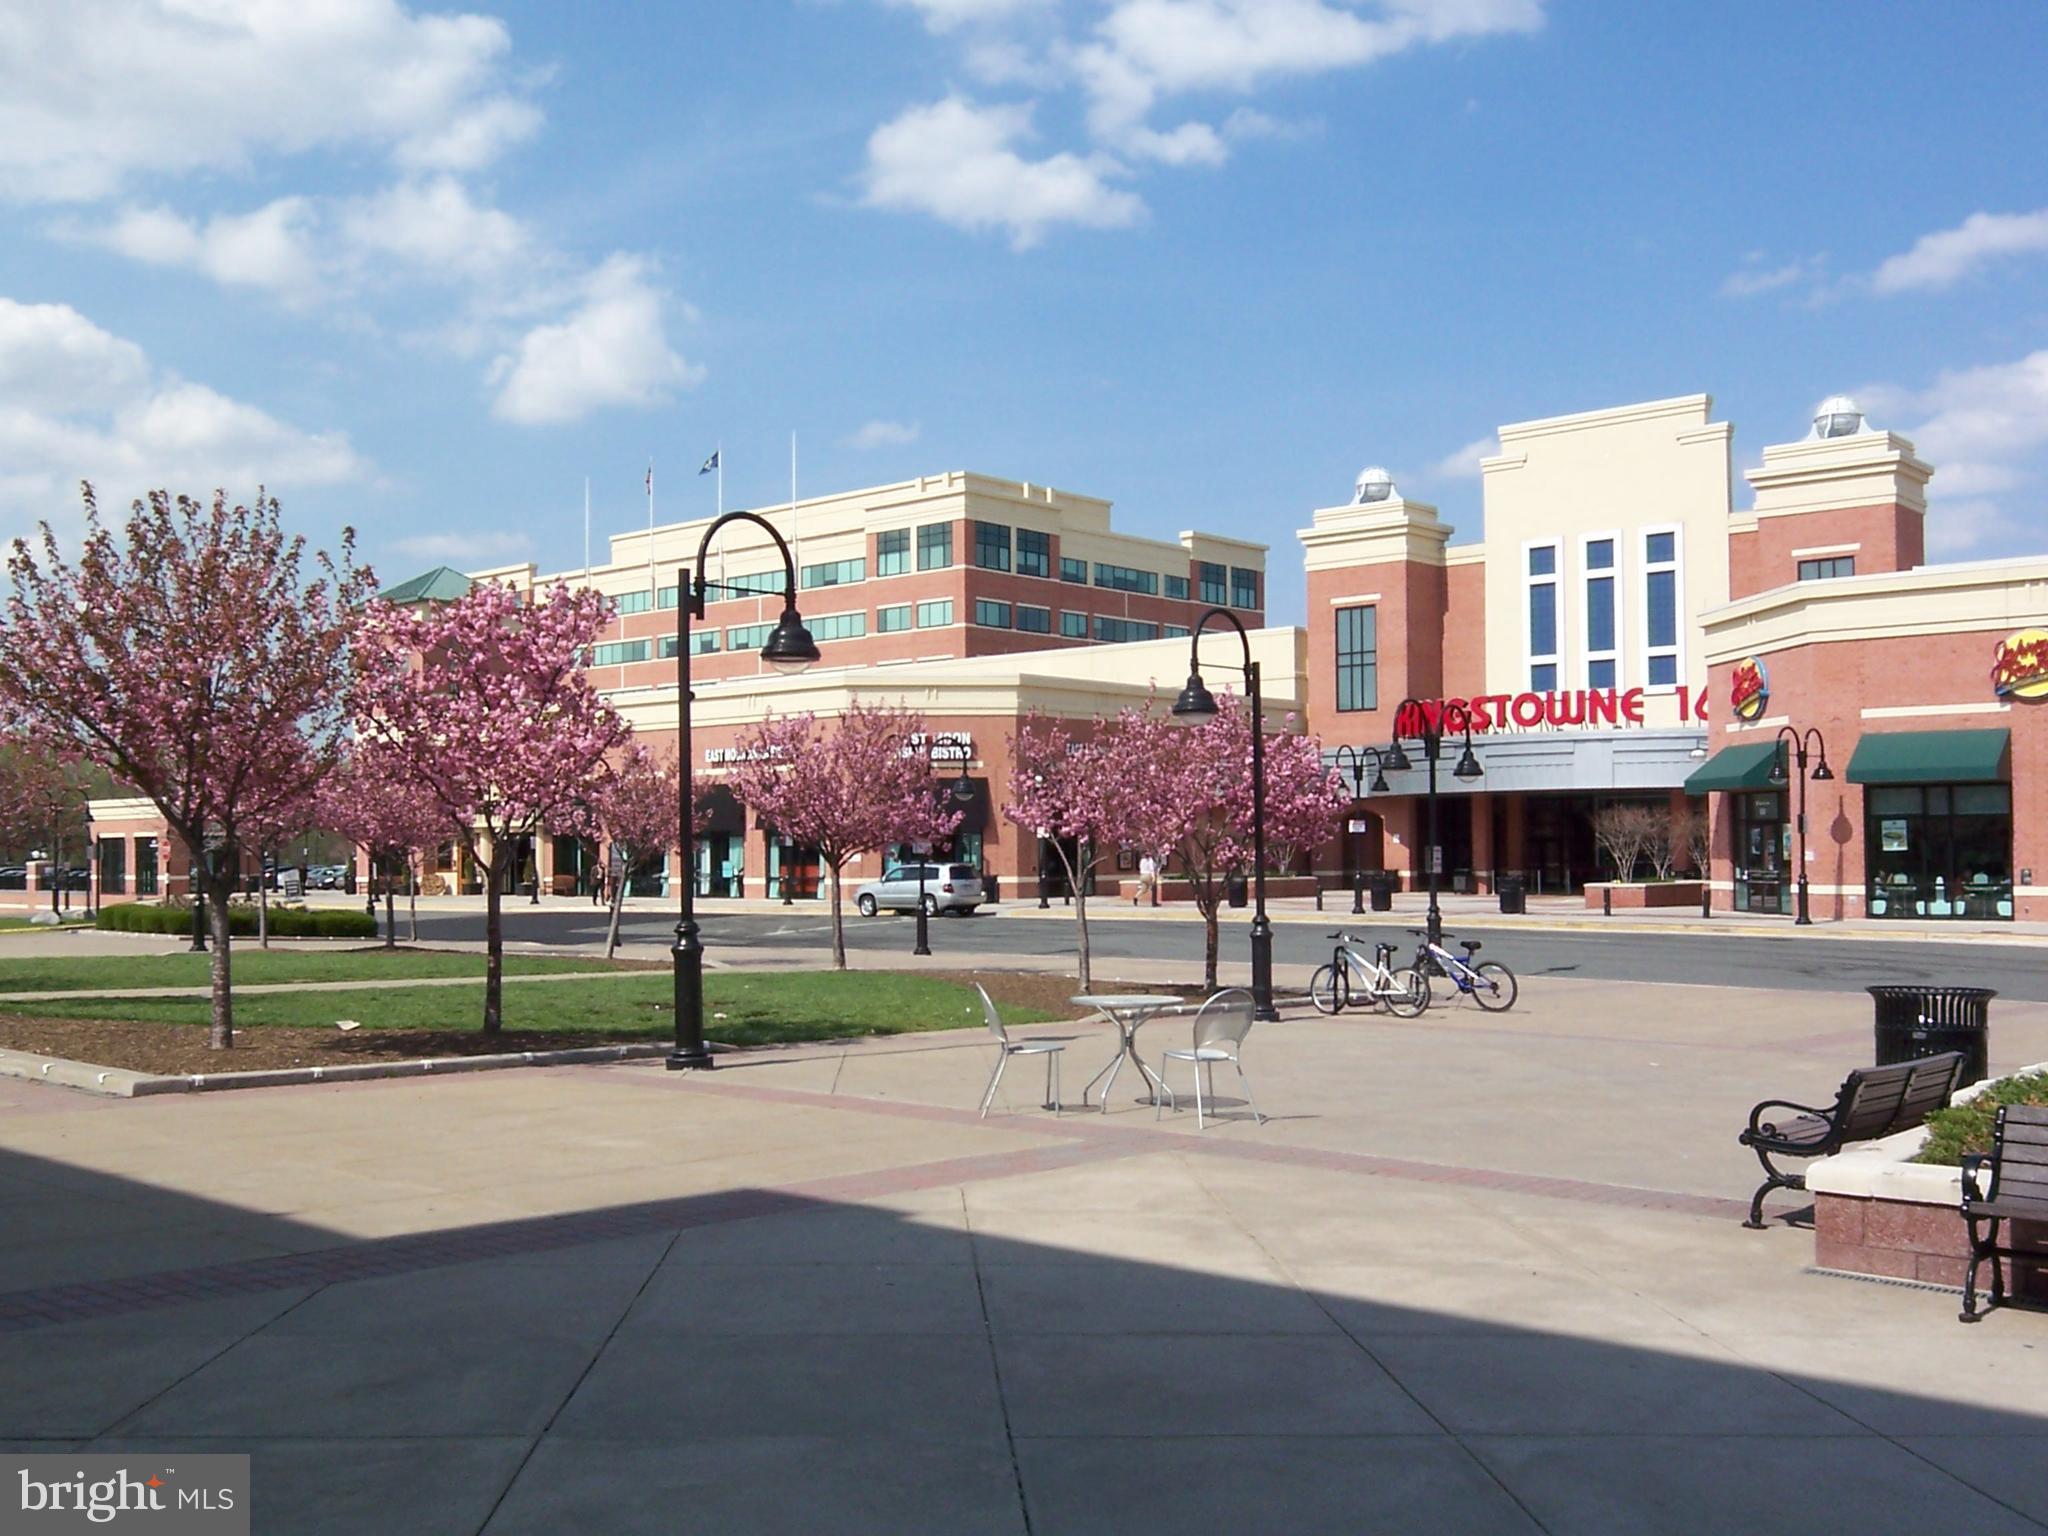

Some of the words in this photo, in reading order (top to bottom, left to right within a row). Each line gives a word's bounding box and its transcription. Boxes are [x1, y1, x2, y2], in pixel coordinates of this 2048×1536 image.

[1396, 687, 1644, 738] KINGSTOWNE
[705, 748, 723, 763] EAST
[931, 746, 972, 760] BISTRO
